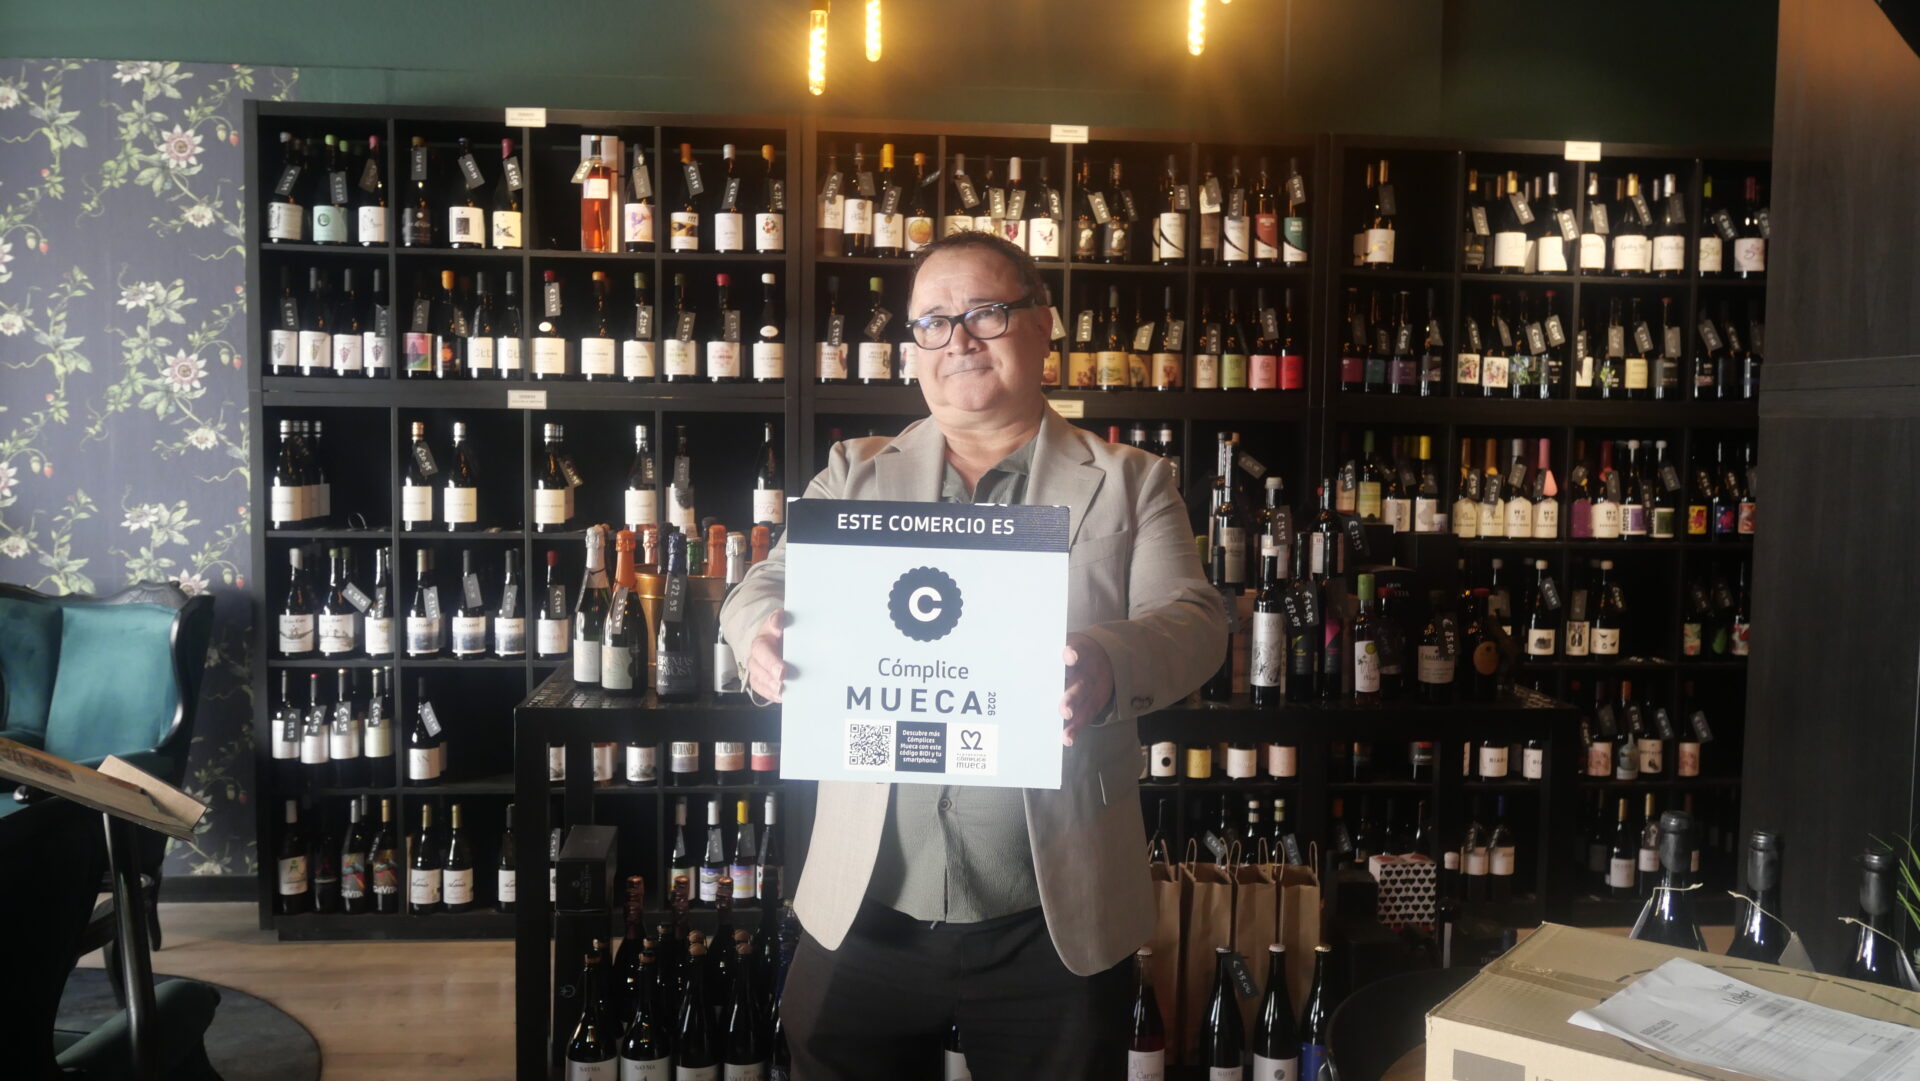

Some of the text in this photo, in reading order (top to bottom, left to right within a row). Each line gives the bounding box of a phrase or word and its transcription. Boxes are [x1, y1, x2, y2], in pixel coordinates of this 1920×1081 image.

[837, 513, 1015, 536] ESTE COMERCIO ES
[908, 586, 943, 622] C
[877, 657, 969, 684] Cómplice
[846, 686, 983, 715] MUECA
[987, 691, 997, 716] 2026
[902, 729, 928, 737] Descubre
[907, 736, 936, 744] Cómplices
